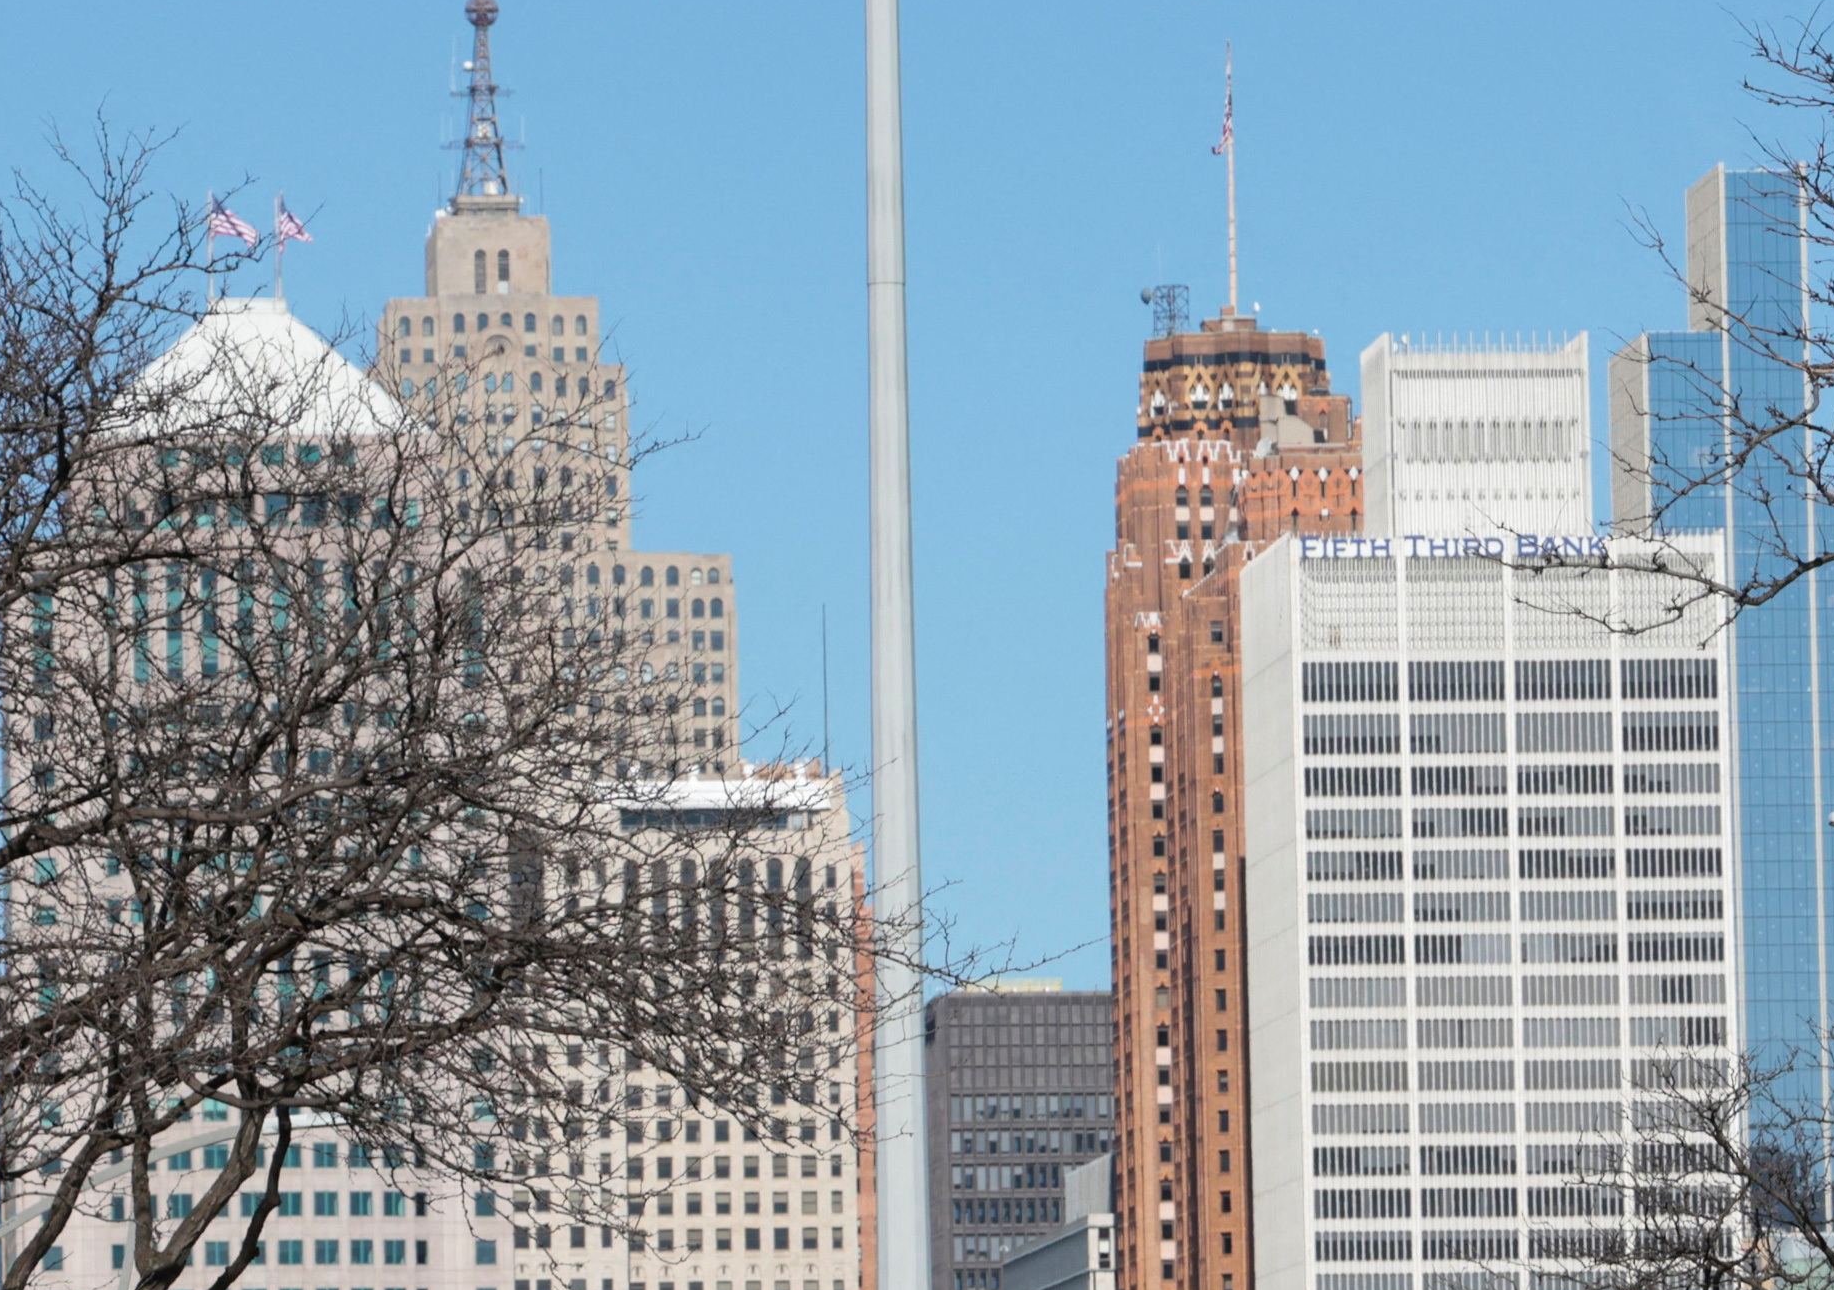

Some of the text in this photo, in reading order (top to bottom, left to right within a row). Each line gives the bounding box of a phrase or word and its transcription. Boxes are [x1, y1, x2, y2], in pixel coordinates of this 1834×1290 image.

[1299, 534, 1607, 560] FIFTH THIRD BANK
